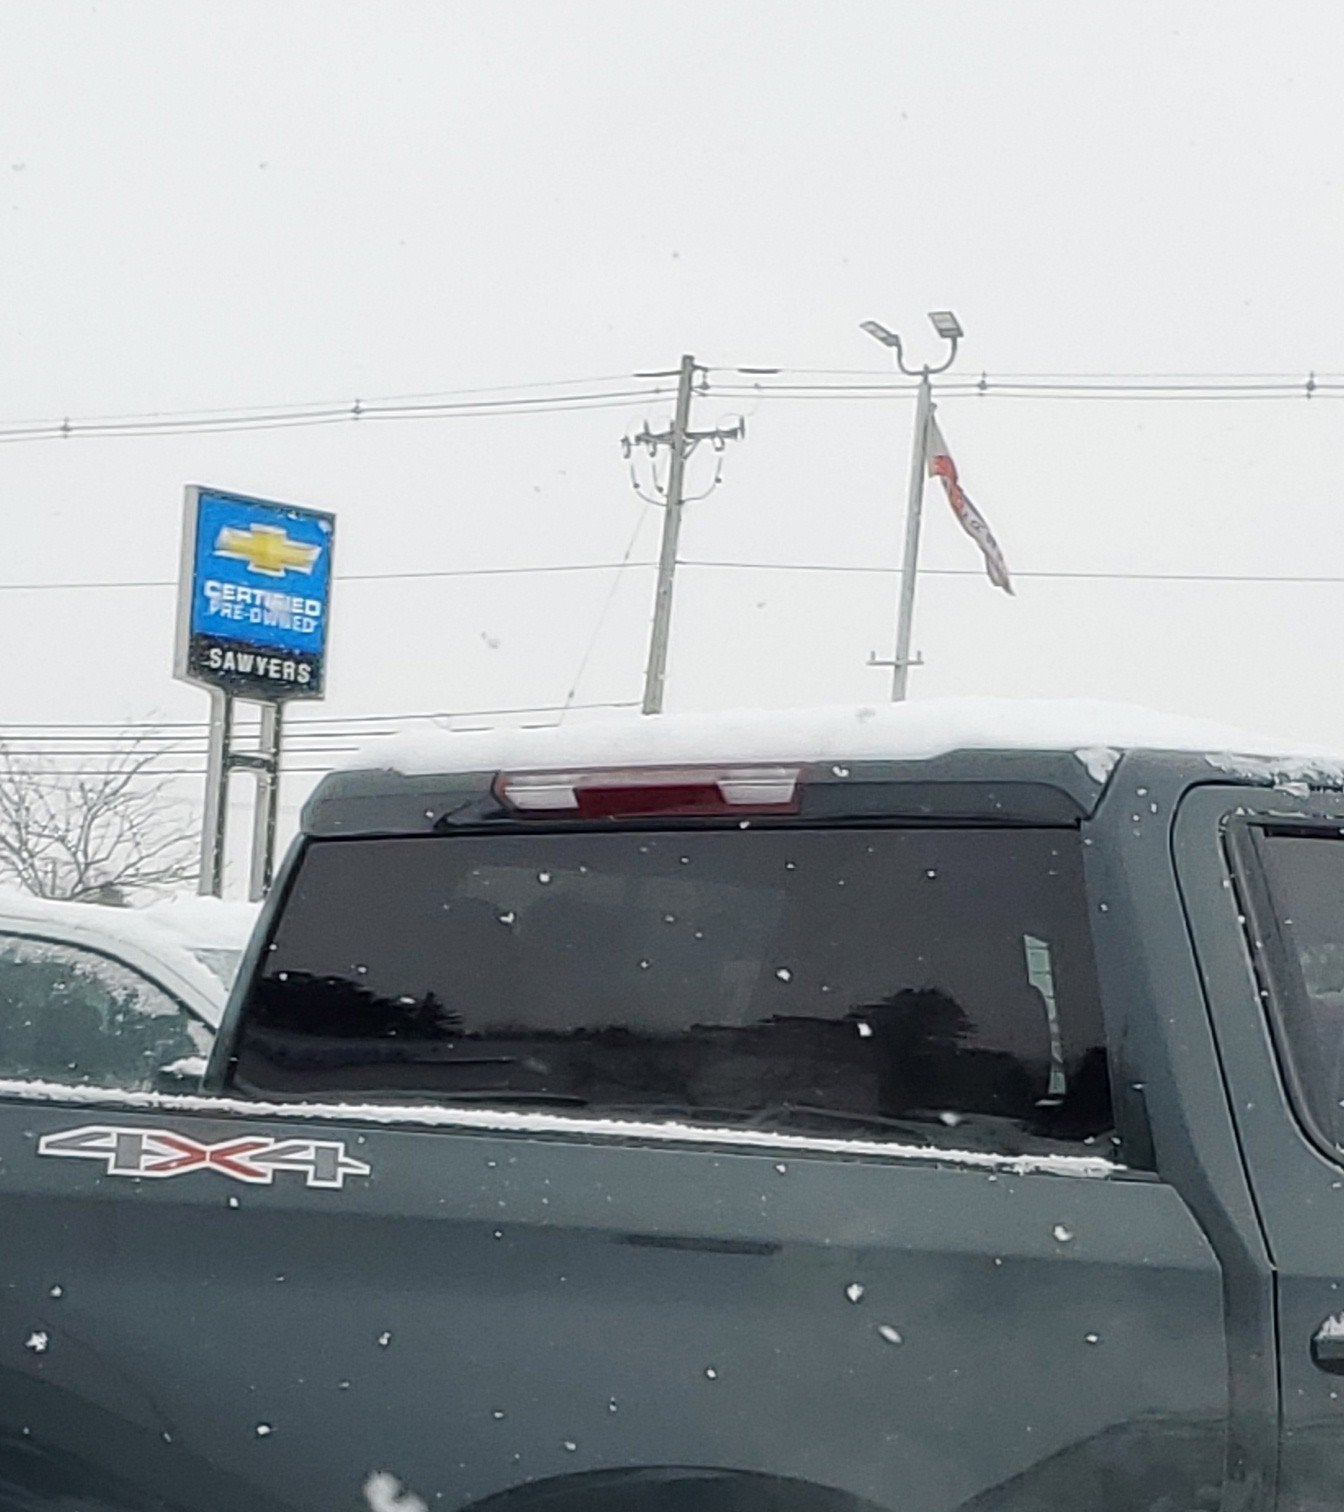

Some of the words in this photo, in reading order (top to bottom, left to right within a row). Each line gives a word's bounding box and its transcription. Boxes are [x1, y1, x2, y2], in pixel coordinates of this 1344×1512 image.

[203, 579, 322, 616] CERTIFIED
[208, 599, 318, 634] PRE-OWNED
[208, 648, 312, 684] SAWYERS
